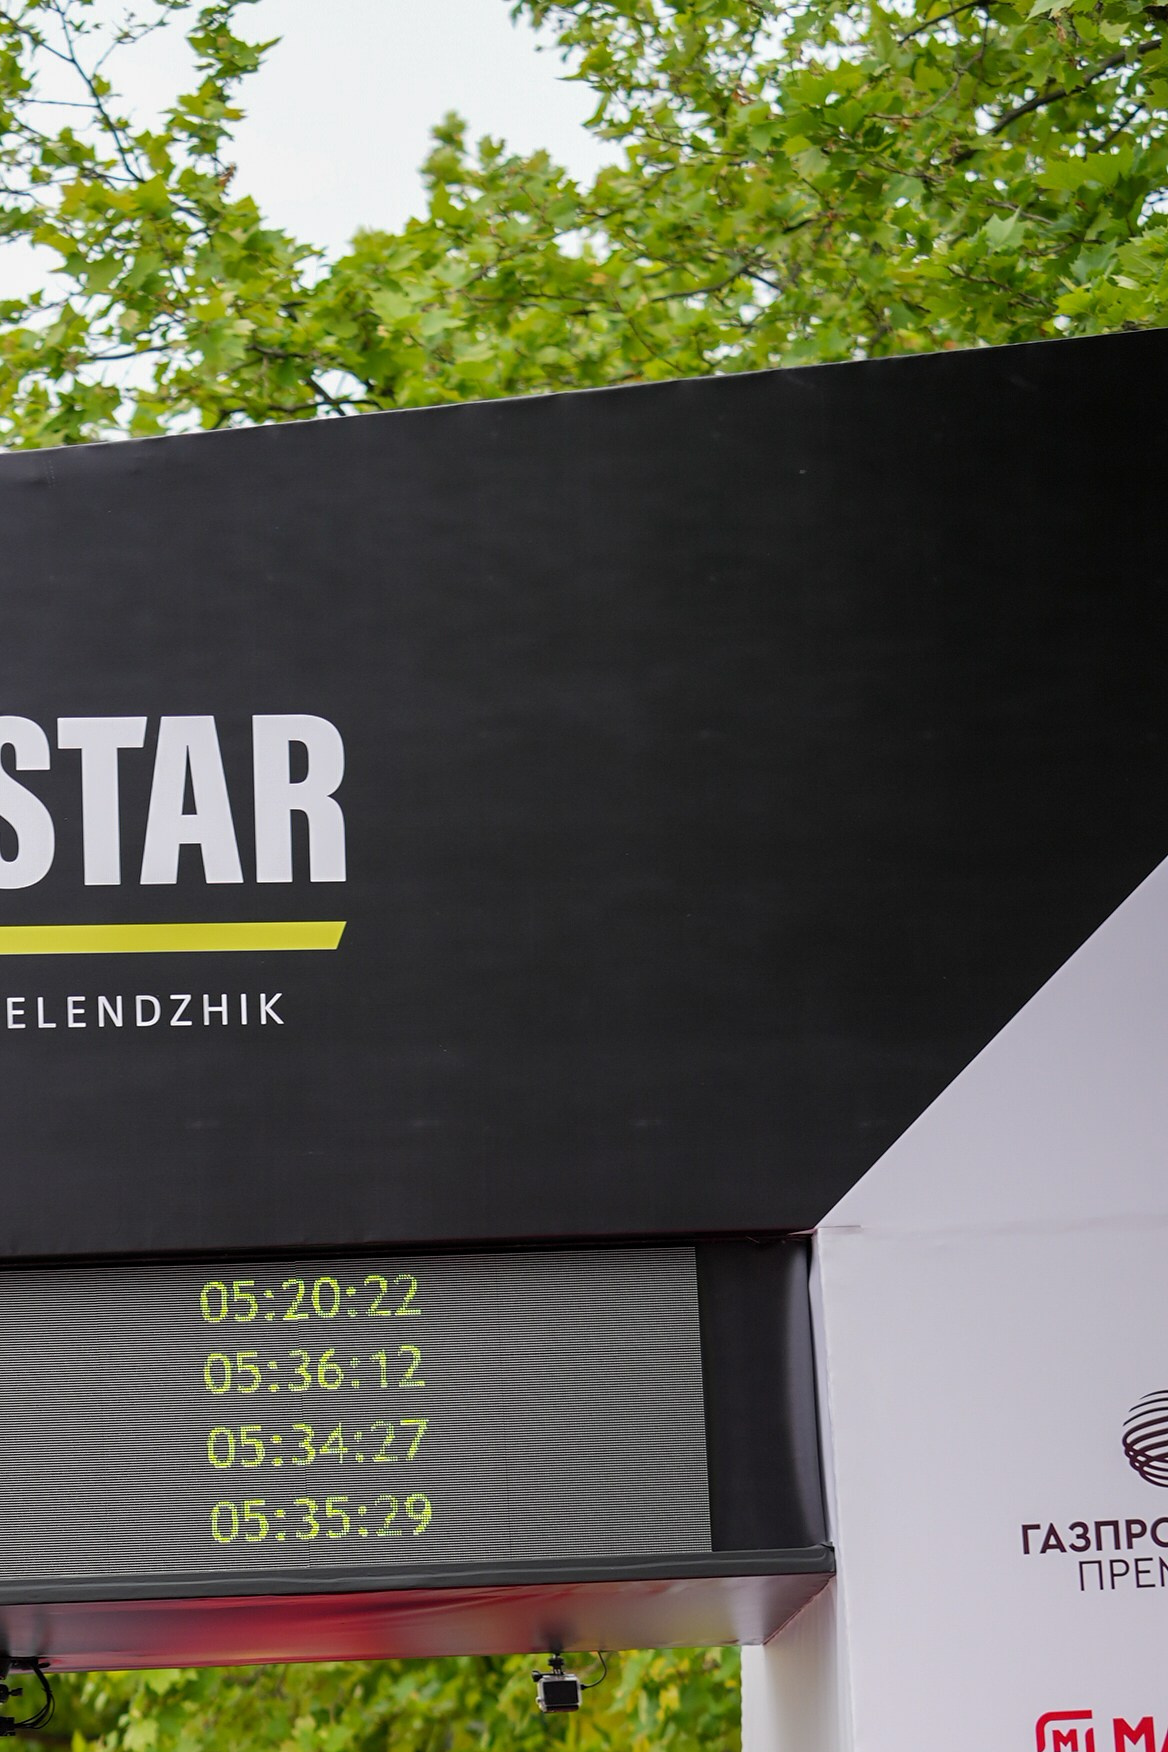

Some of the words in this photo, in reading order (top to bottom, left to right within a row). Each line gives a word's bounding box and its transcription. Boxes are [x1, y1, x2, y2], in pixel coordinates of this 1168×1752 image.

[199, 1273, 423, 1323] 05:20:22
[203, 1344, 426, 1394] 05:36:12
[207, 1419, 430, 1468] 05:34:27
[209, 1493, 433, 1543] 05:35:29
[1078, 1557, 1168, 1592] ПРЕ
